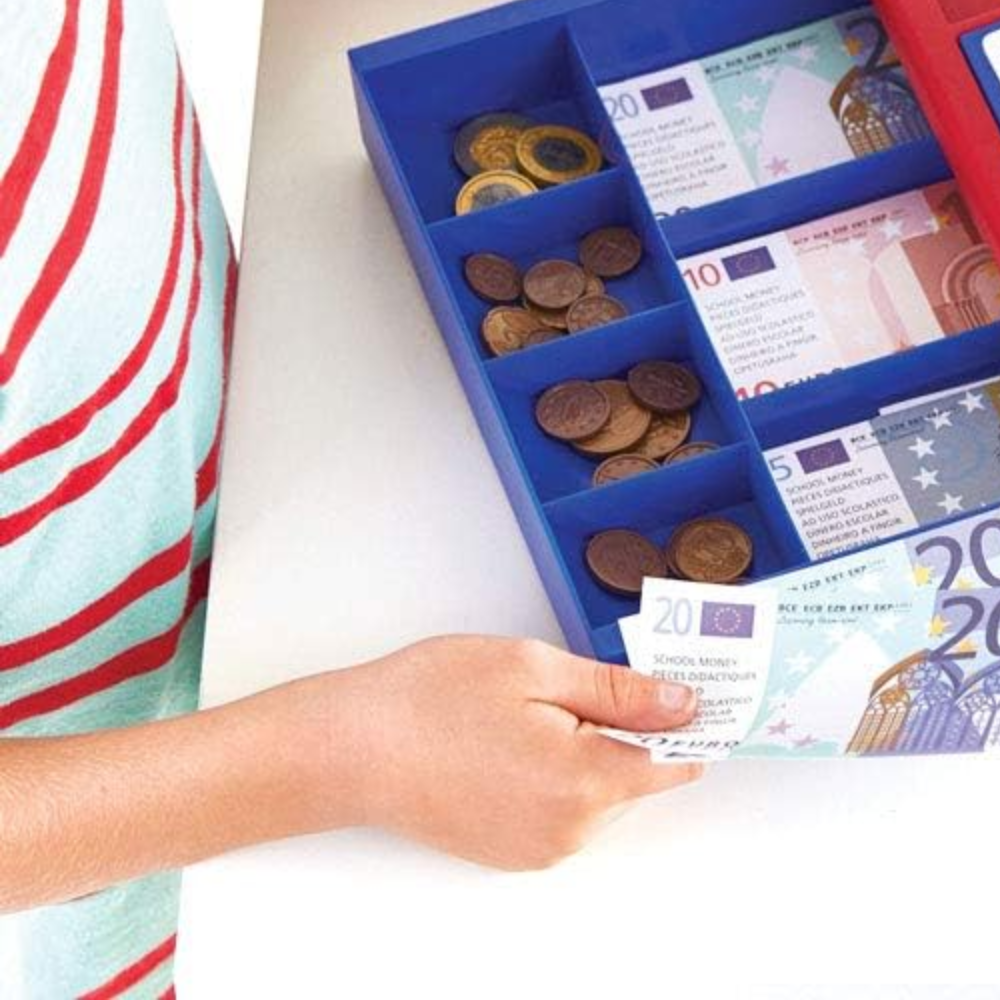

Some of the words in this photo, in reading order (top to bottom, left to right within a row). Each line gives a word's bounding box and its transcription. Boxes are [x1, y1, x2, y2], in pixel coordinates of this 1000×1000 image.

[682, 262, 722, 291] 10
[769, 455, 793, 482] 5
[786, 480, 826, 495] SCHOOL
[827, 468, 862, 483] MONEY
[824, 473, 889, 497] DIDACTIQUES
[802, 516, 817, 527] AD
[818, 511, 838, 523] USO
[840, 494, 900, 516] SCOLASTICO
[805, 522, 844, 539] DINERO
[845, 509, 889, 527] ESCOLAR
[652, 596, 694, 636] 20
[653, 653, 695, 667] SCHOOL
[699, 656, 738, 668] MONEY
